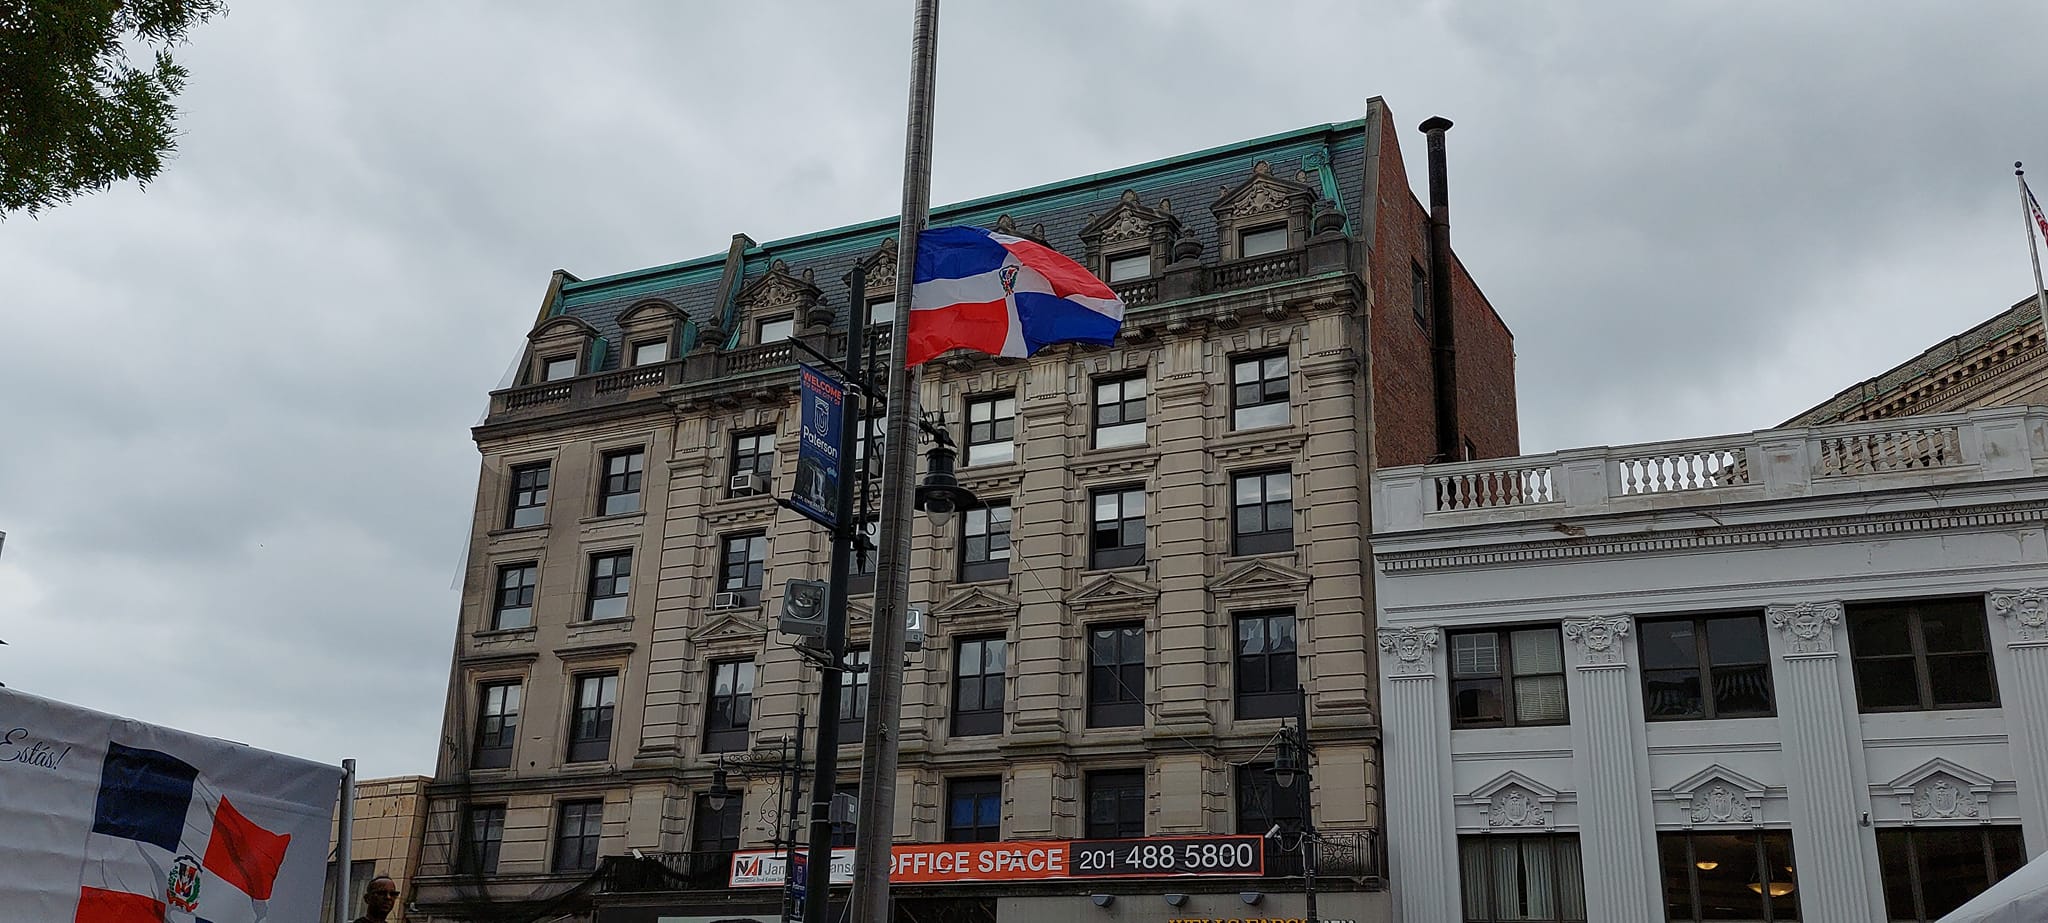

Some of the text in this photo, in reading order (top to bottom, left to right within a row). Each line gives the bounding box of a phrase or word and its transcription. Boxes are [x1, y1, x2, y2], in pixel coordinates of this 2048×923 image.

[803, 372, 842, 400] WELCOME
[803, 425, 838, 458] Paterson
[0, 728, 71, 770] Estás!
[735, 856, 763, 876] NAI
[978, 849, 1063, 873] SPACE
[1079, 843, 1253, 870] 201 488 5800
